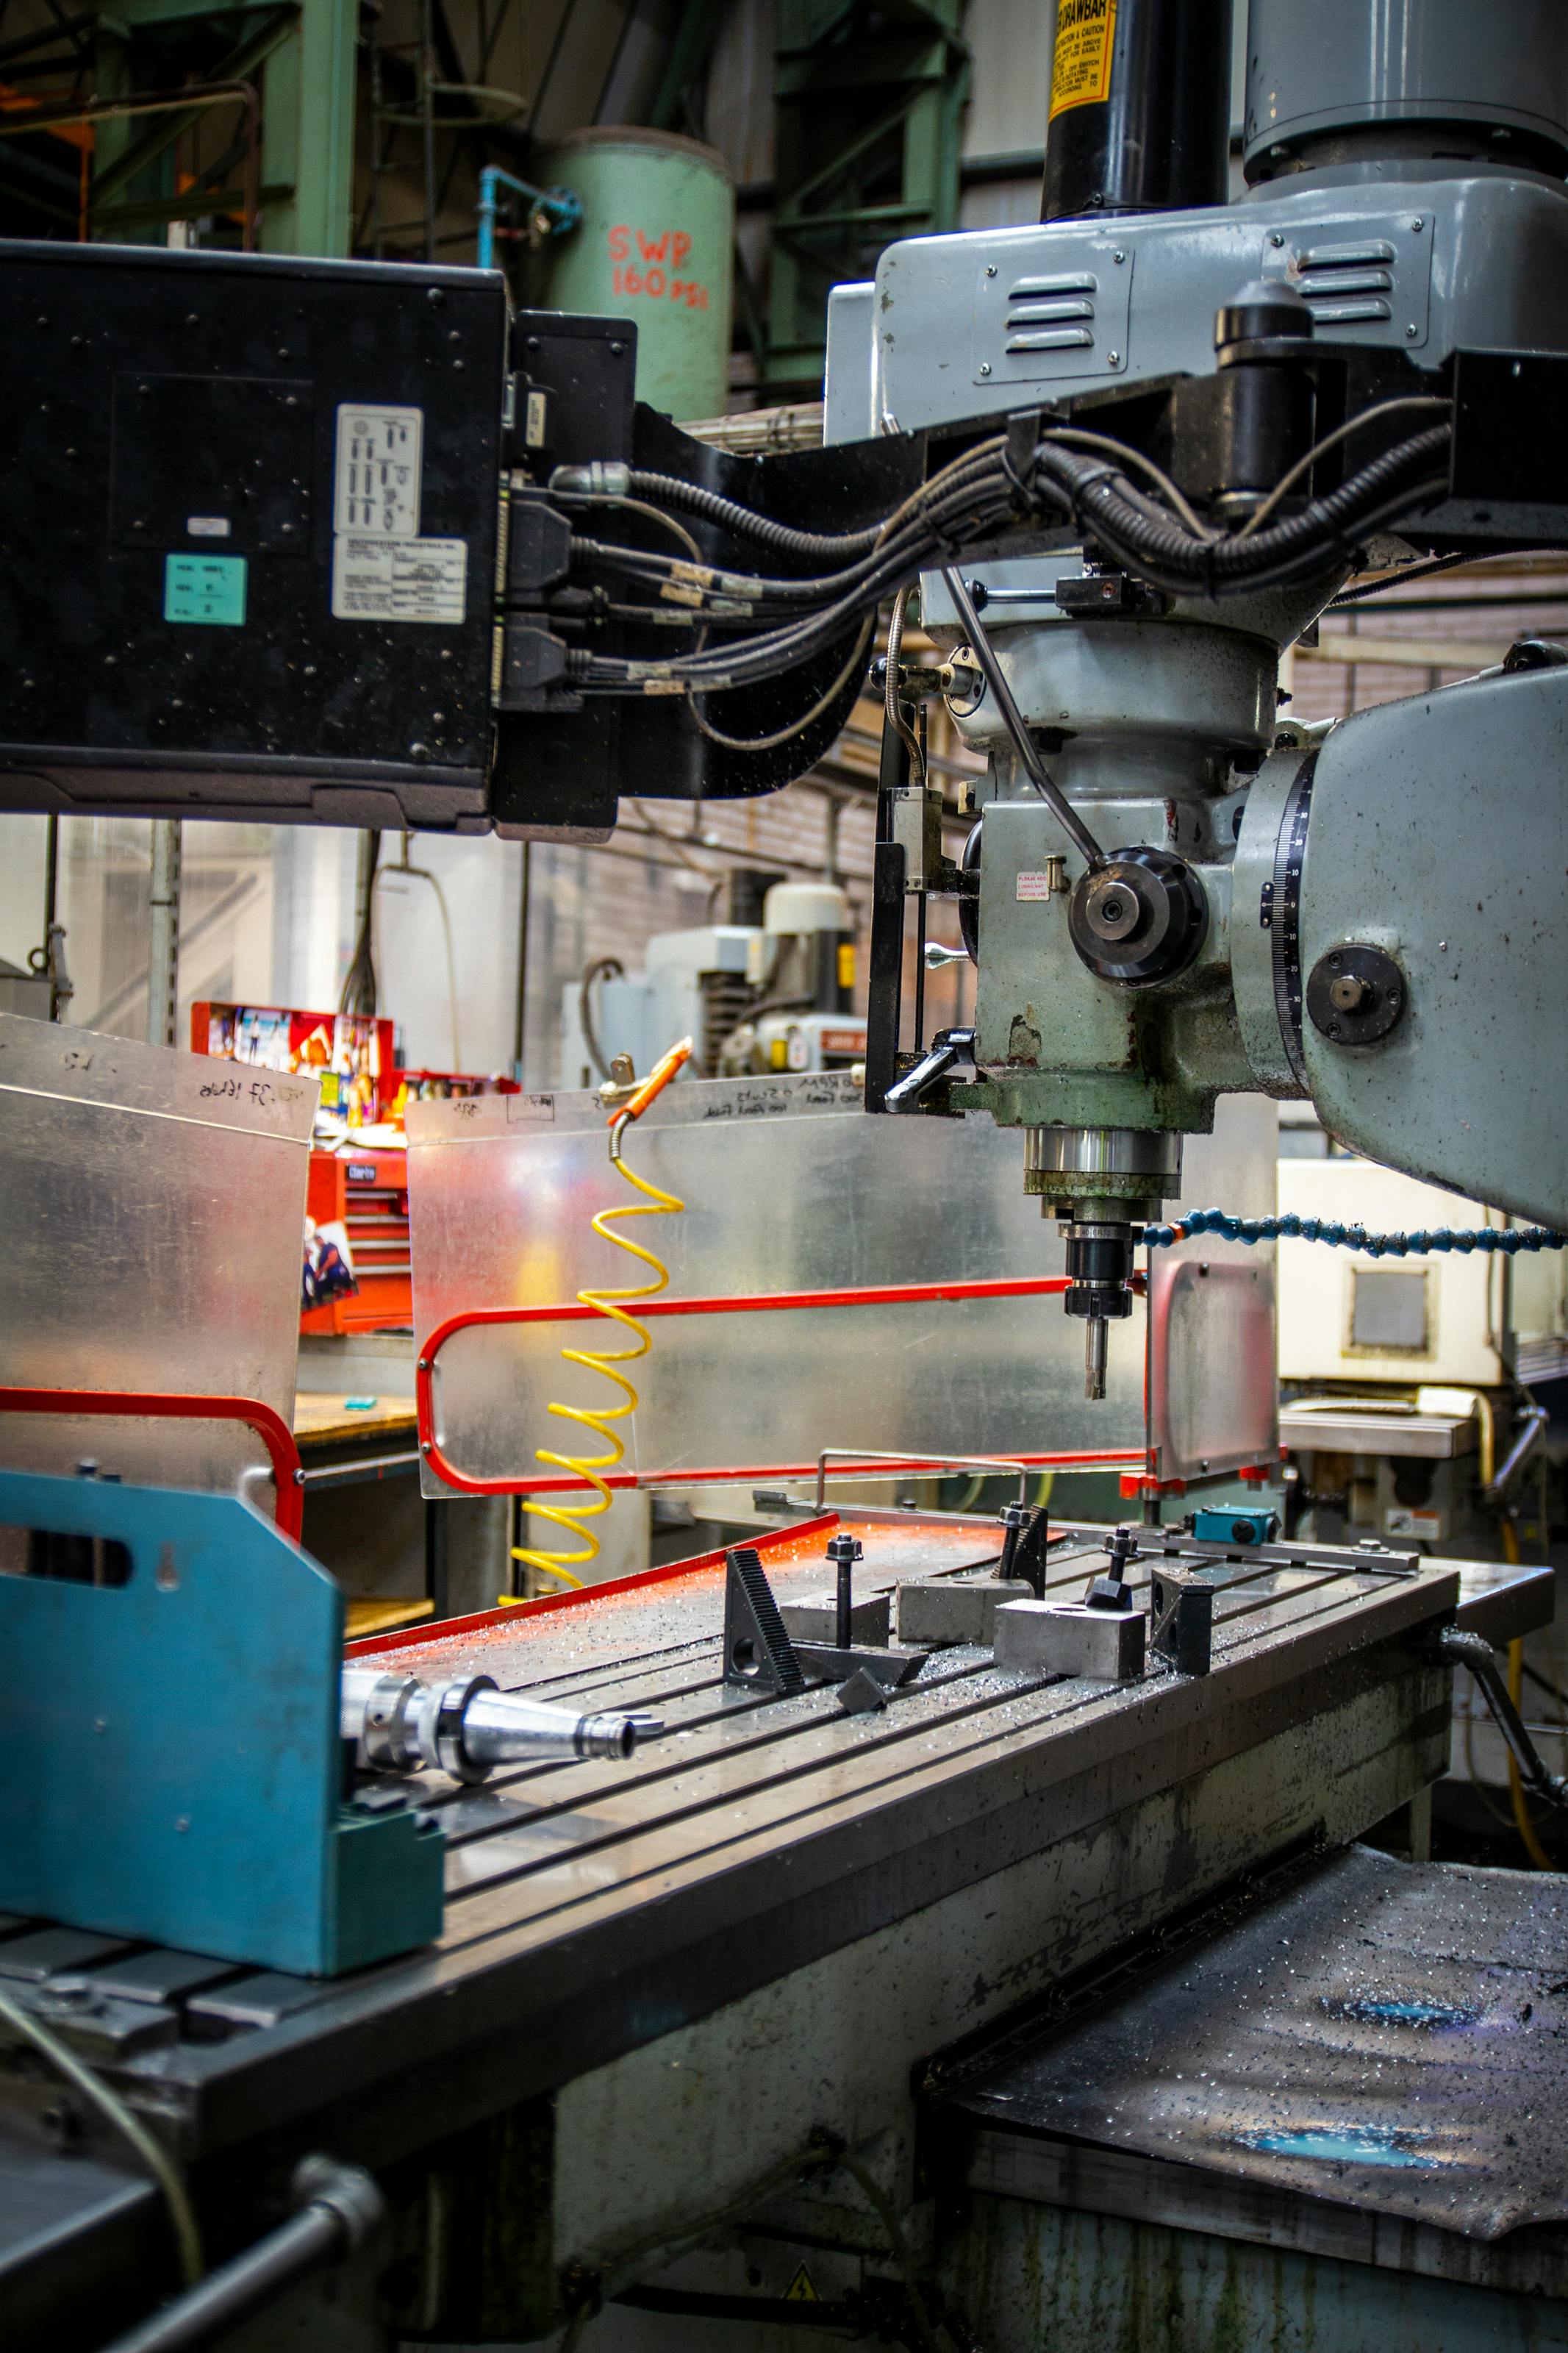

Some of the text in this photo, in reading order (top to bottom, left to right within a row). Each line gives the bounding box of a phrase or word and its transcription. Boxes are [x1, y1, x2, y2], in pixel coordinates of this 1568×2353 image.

[1081, 24, 1105, 37] CAUTION
[1083, 38, 1101, 46] ABOVE
[1078, 59, 1100, 69] SWITCH
[612, 264, 667, 299] 160
[1290, 901, 1296, 909] 0
[1289, 932, 1297, 940] 10
[1290, 965, 1298, 973] 20
